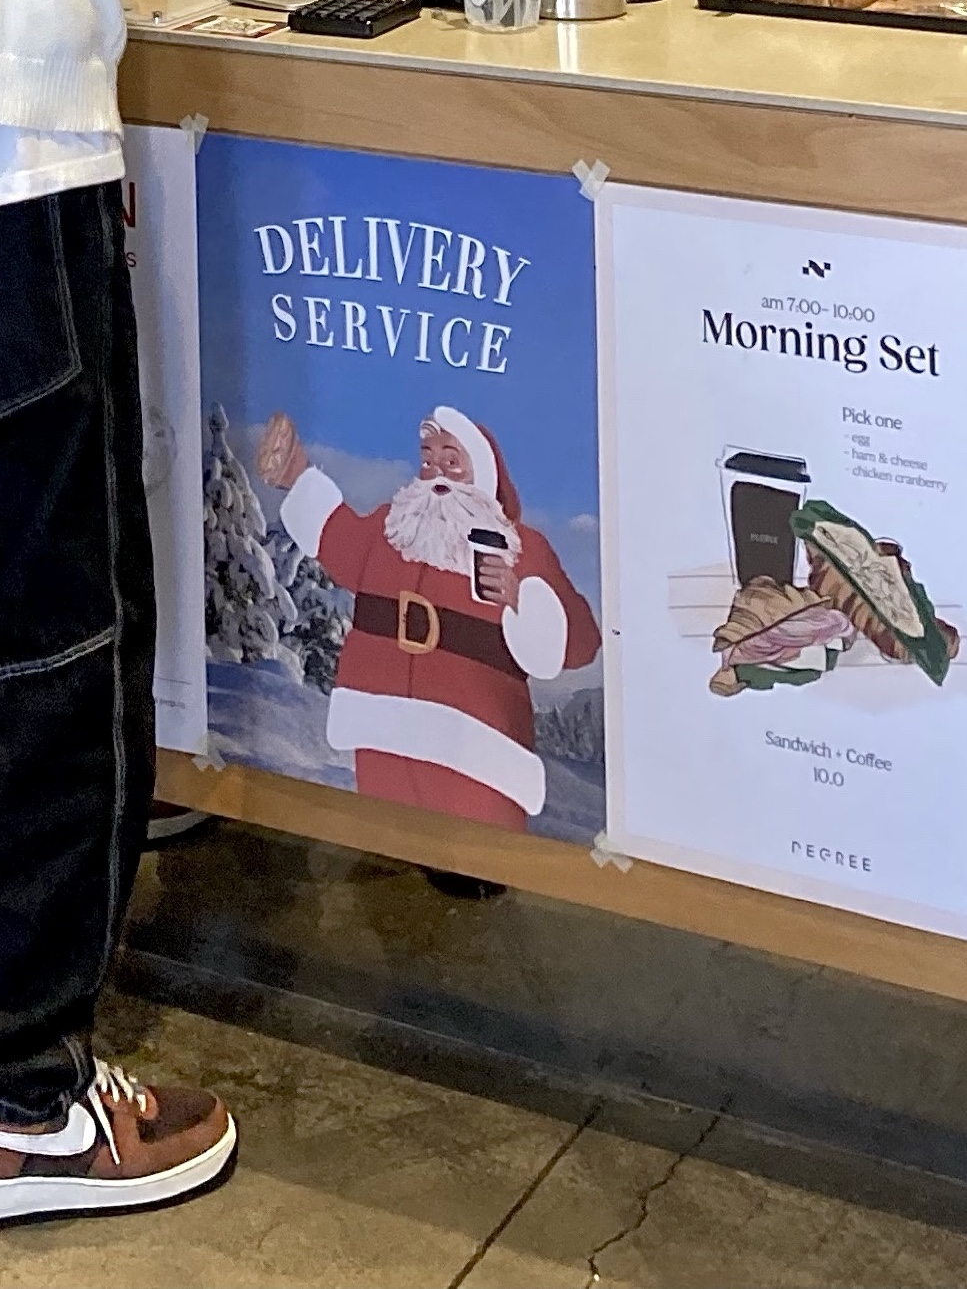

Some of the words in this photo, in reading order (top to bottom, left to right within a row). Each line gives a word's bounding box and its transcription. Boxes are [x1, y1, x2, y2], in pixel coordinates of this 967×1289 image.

[254, 216, 531, 307] DELIVERY
[761, 297, 783, 311] am
[271, 293, 512, 374] SERVICE
[702, 309, 868, 374] Morning
[879, 334, 940, 377] Set
[842, 406, 872, 426] Pick
[874, 415, 903, 430] one
[851, 448, 876, 462] ham
[890, 455, 928, 471] cheese
[852, 465, 892, 482] chicken
[894, 474, 949, 493] cranberry
[765, 730, 832, 759] Sandwich
[845, 748, 893, 771] Coffee
[813, 766, 845, 787] 10.0
